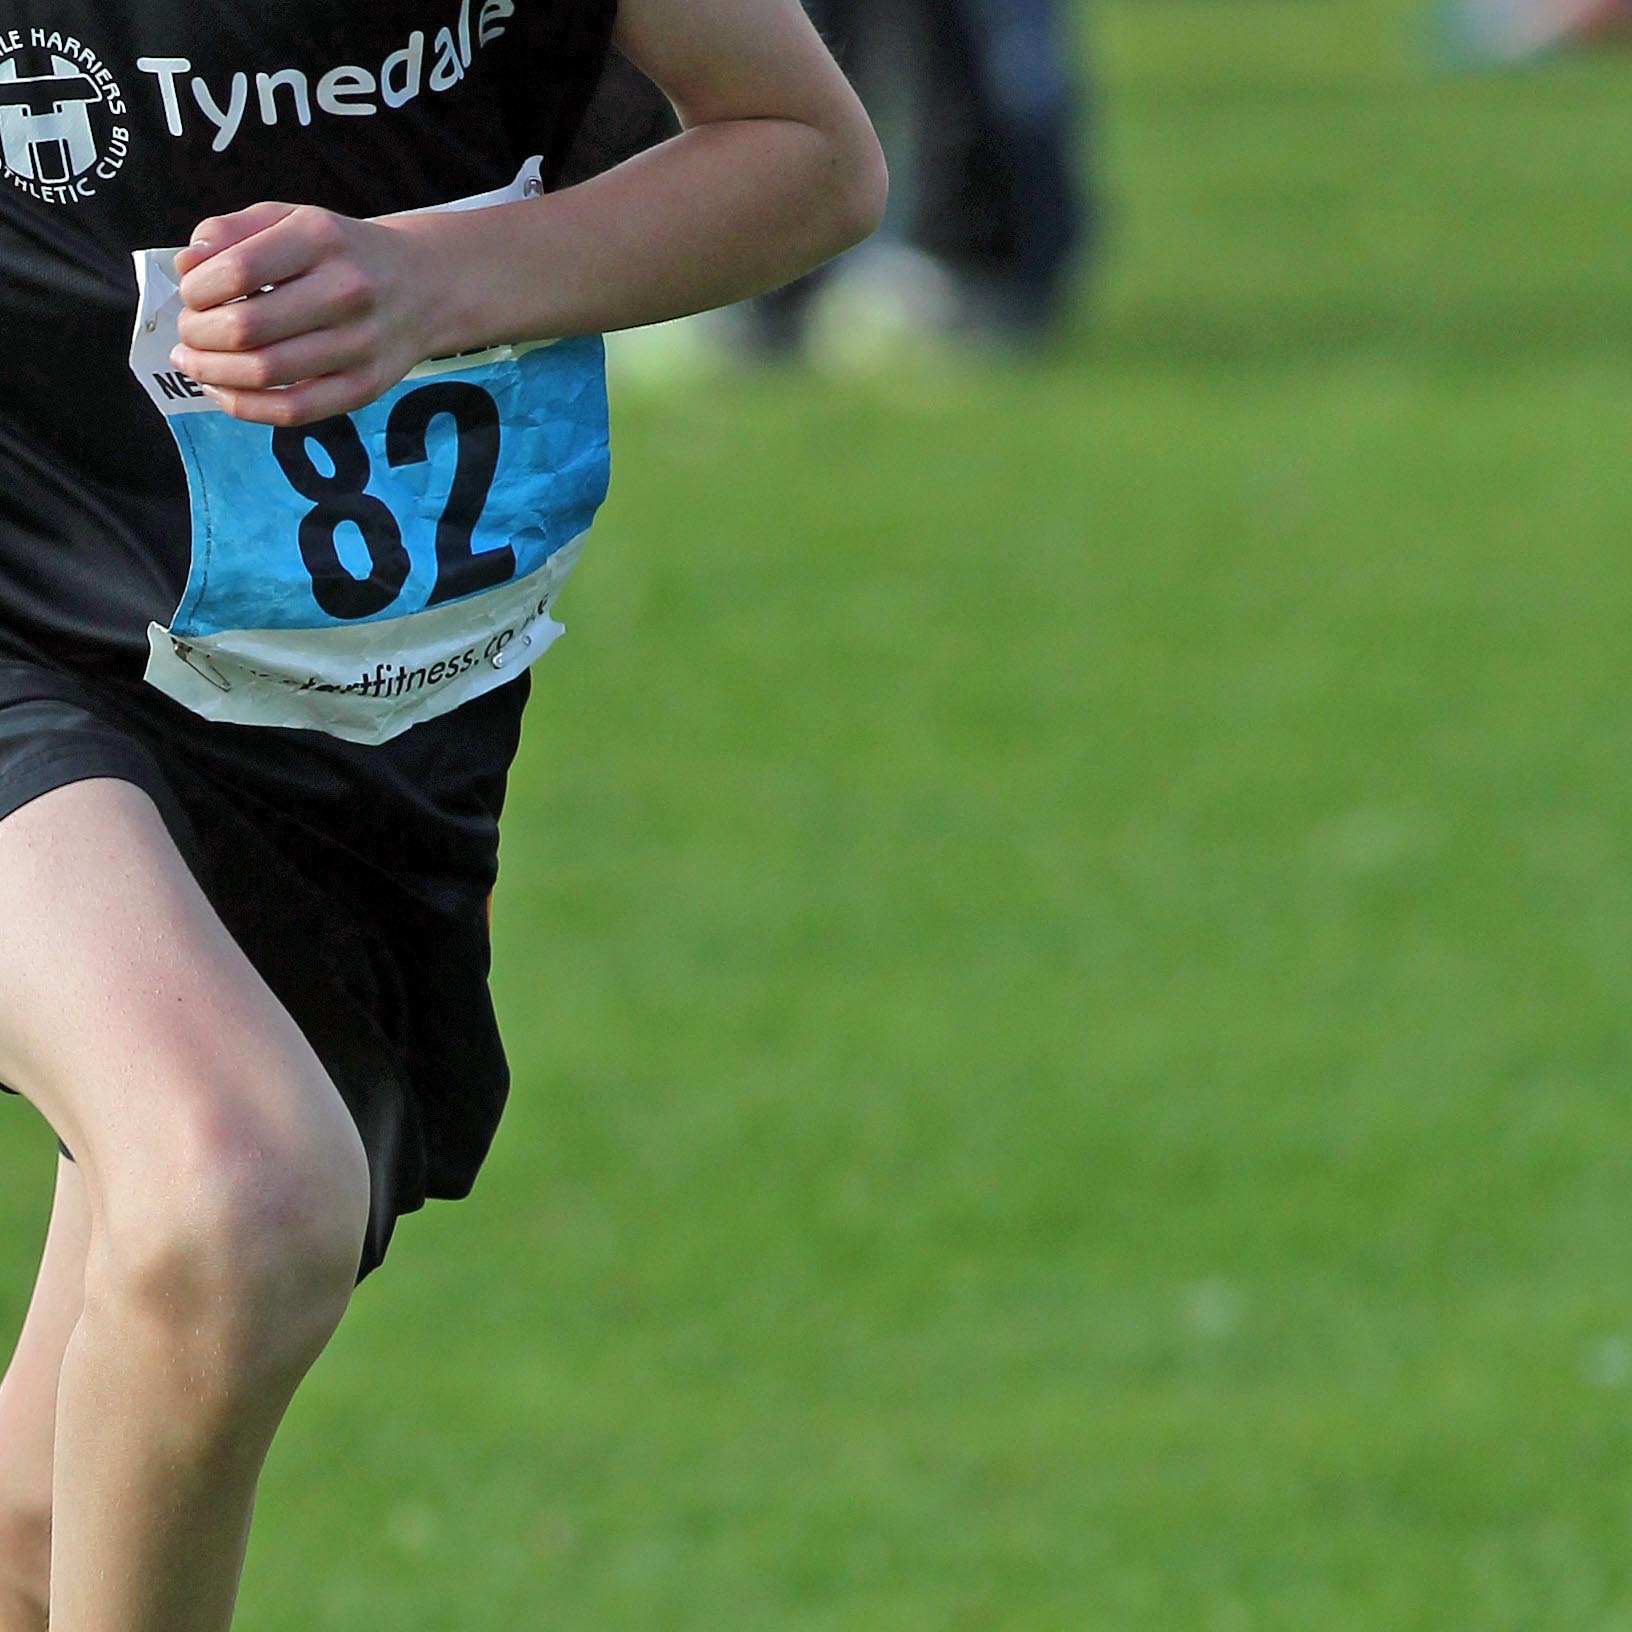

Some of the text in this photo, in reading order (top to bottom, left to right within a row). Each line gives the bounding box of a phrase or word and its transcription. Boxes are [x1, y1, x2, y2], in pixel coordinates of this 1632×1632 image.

[30, 28, 127, 115] HARRIERS
[95, 126, 130, 180] CLUB
[271, 380, 517, 620] 82
